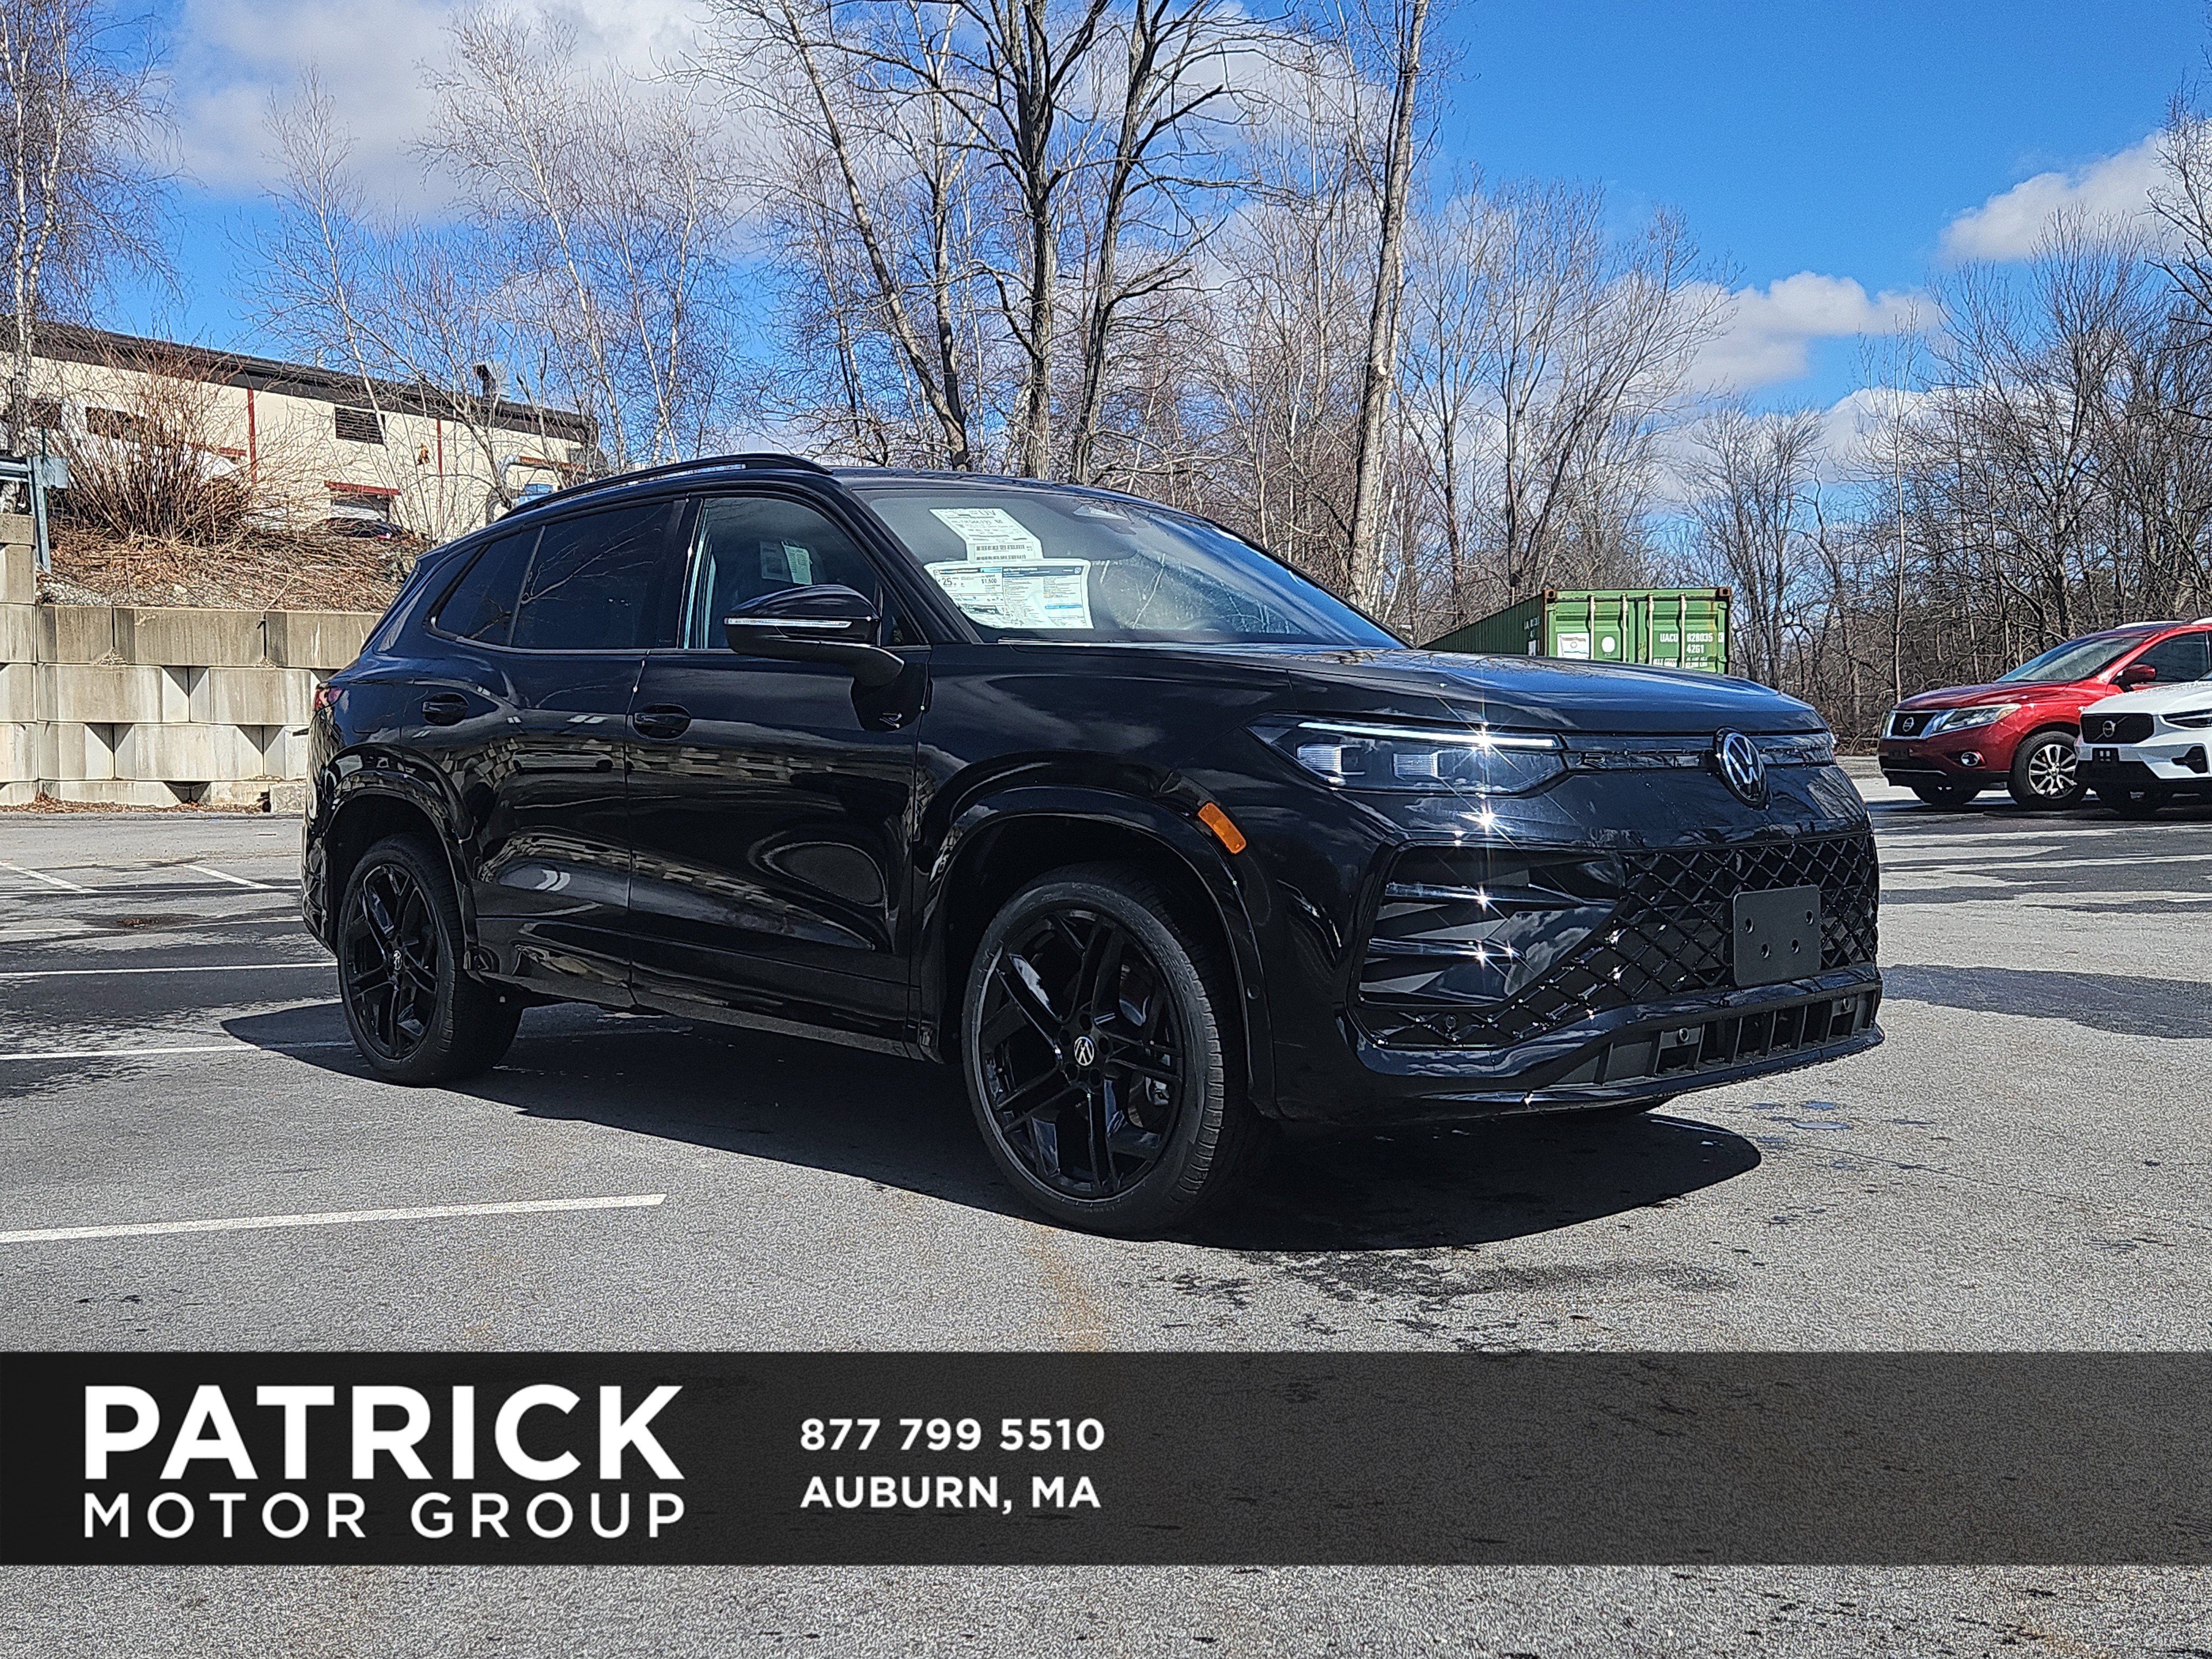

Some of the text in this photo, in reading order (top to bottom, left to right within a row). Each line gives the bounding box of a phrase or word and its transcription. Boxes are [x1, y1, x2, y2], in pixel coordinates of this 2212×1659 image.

[942, 577, 953, 586] 25
[1660, 633, 1679, 643] UACU
[1687, 633, 1713, 642] 828035
